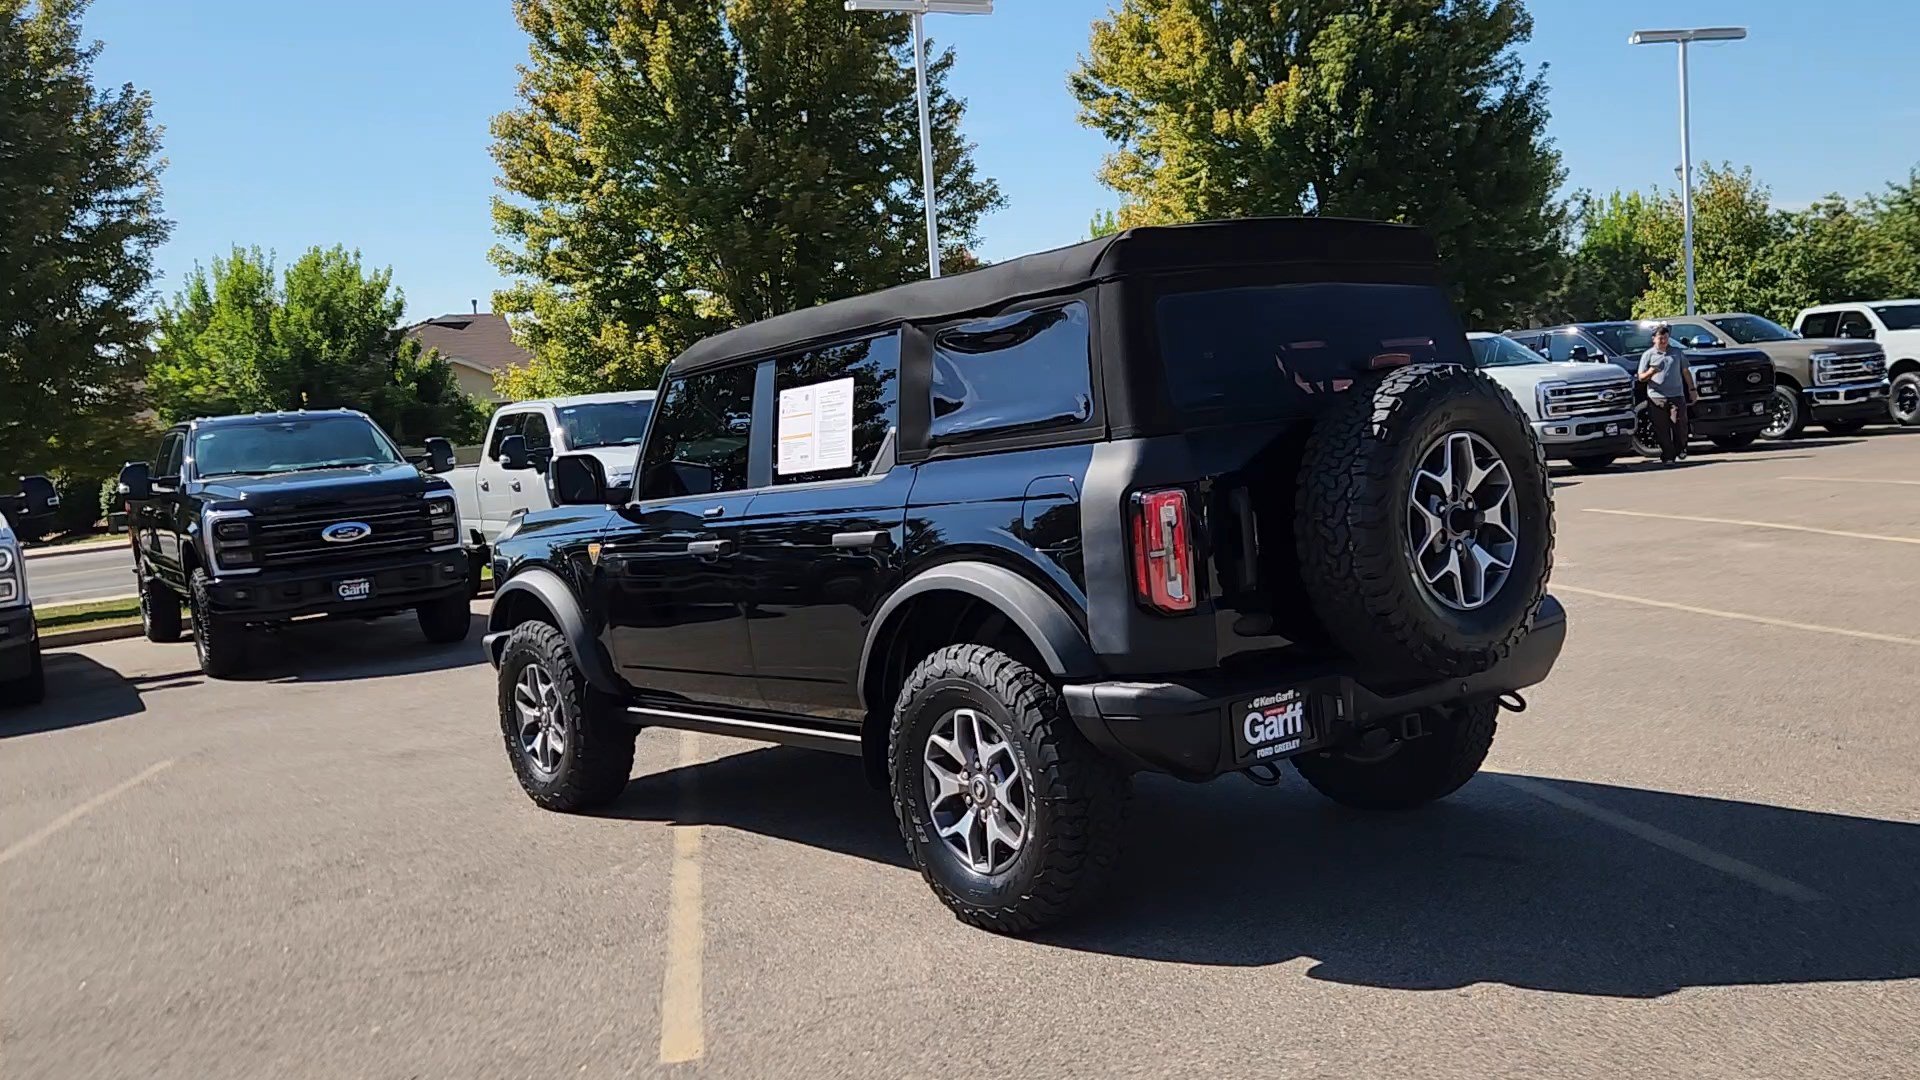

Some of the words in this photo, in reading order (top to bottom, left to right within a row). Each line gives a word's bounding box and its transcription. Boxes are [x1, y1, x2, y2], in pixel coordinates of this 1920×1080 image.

[339, 582, 369, 596] Garff
[1275, 689, 1294, 702] Garff
[1244, 701, 1303, 745] Garff
[1256, 747, 1273, 758] FORD
[1274, 739, 1300, 753] GREELEY
